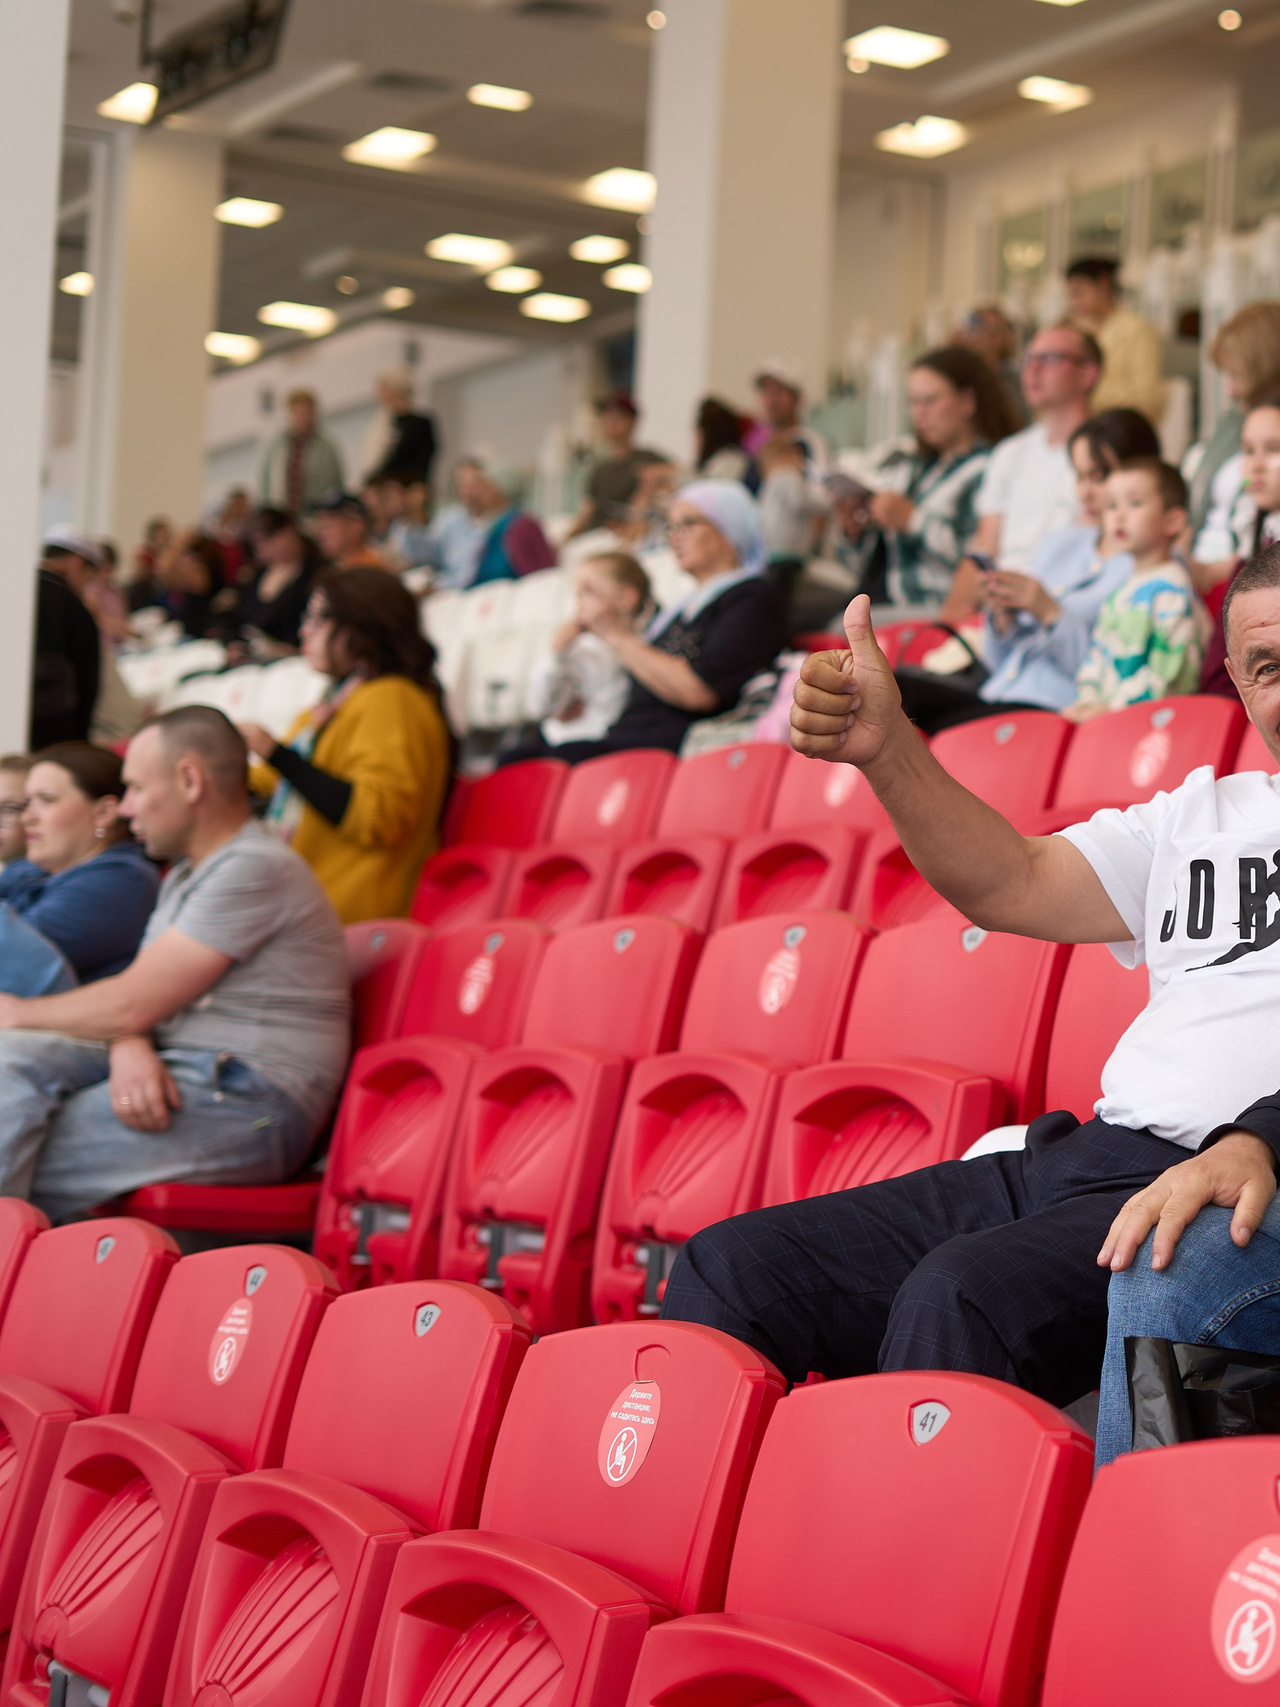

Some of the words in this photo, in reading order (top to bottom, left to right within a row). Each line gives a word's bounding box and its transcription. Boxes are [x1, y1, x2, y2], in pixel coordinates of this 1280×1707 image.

[420, 1310, 434, 1327] 43
[629, 1389, 652, 1400] Держите
[618, 1412, 640, 1422] садитесь
[919, 1411, 938, 1433] 41
